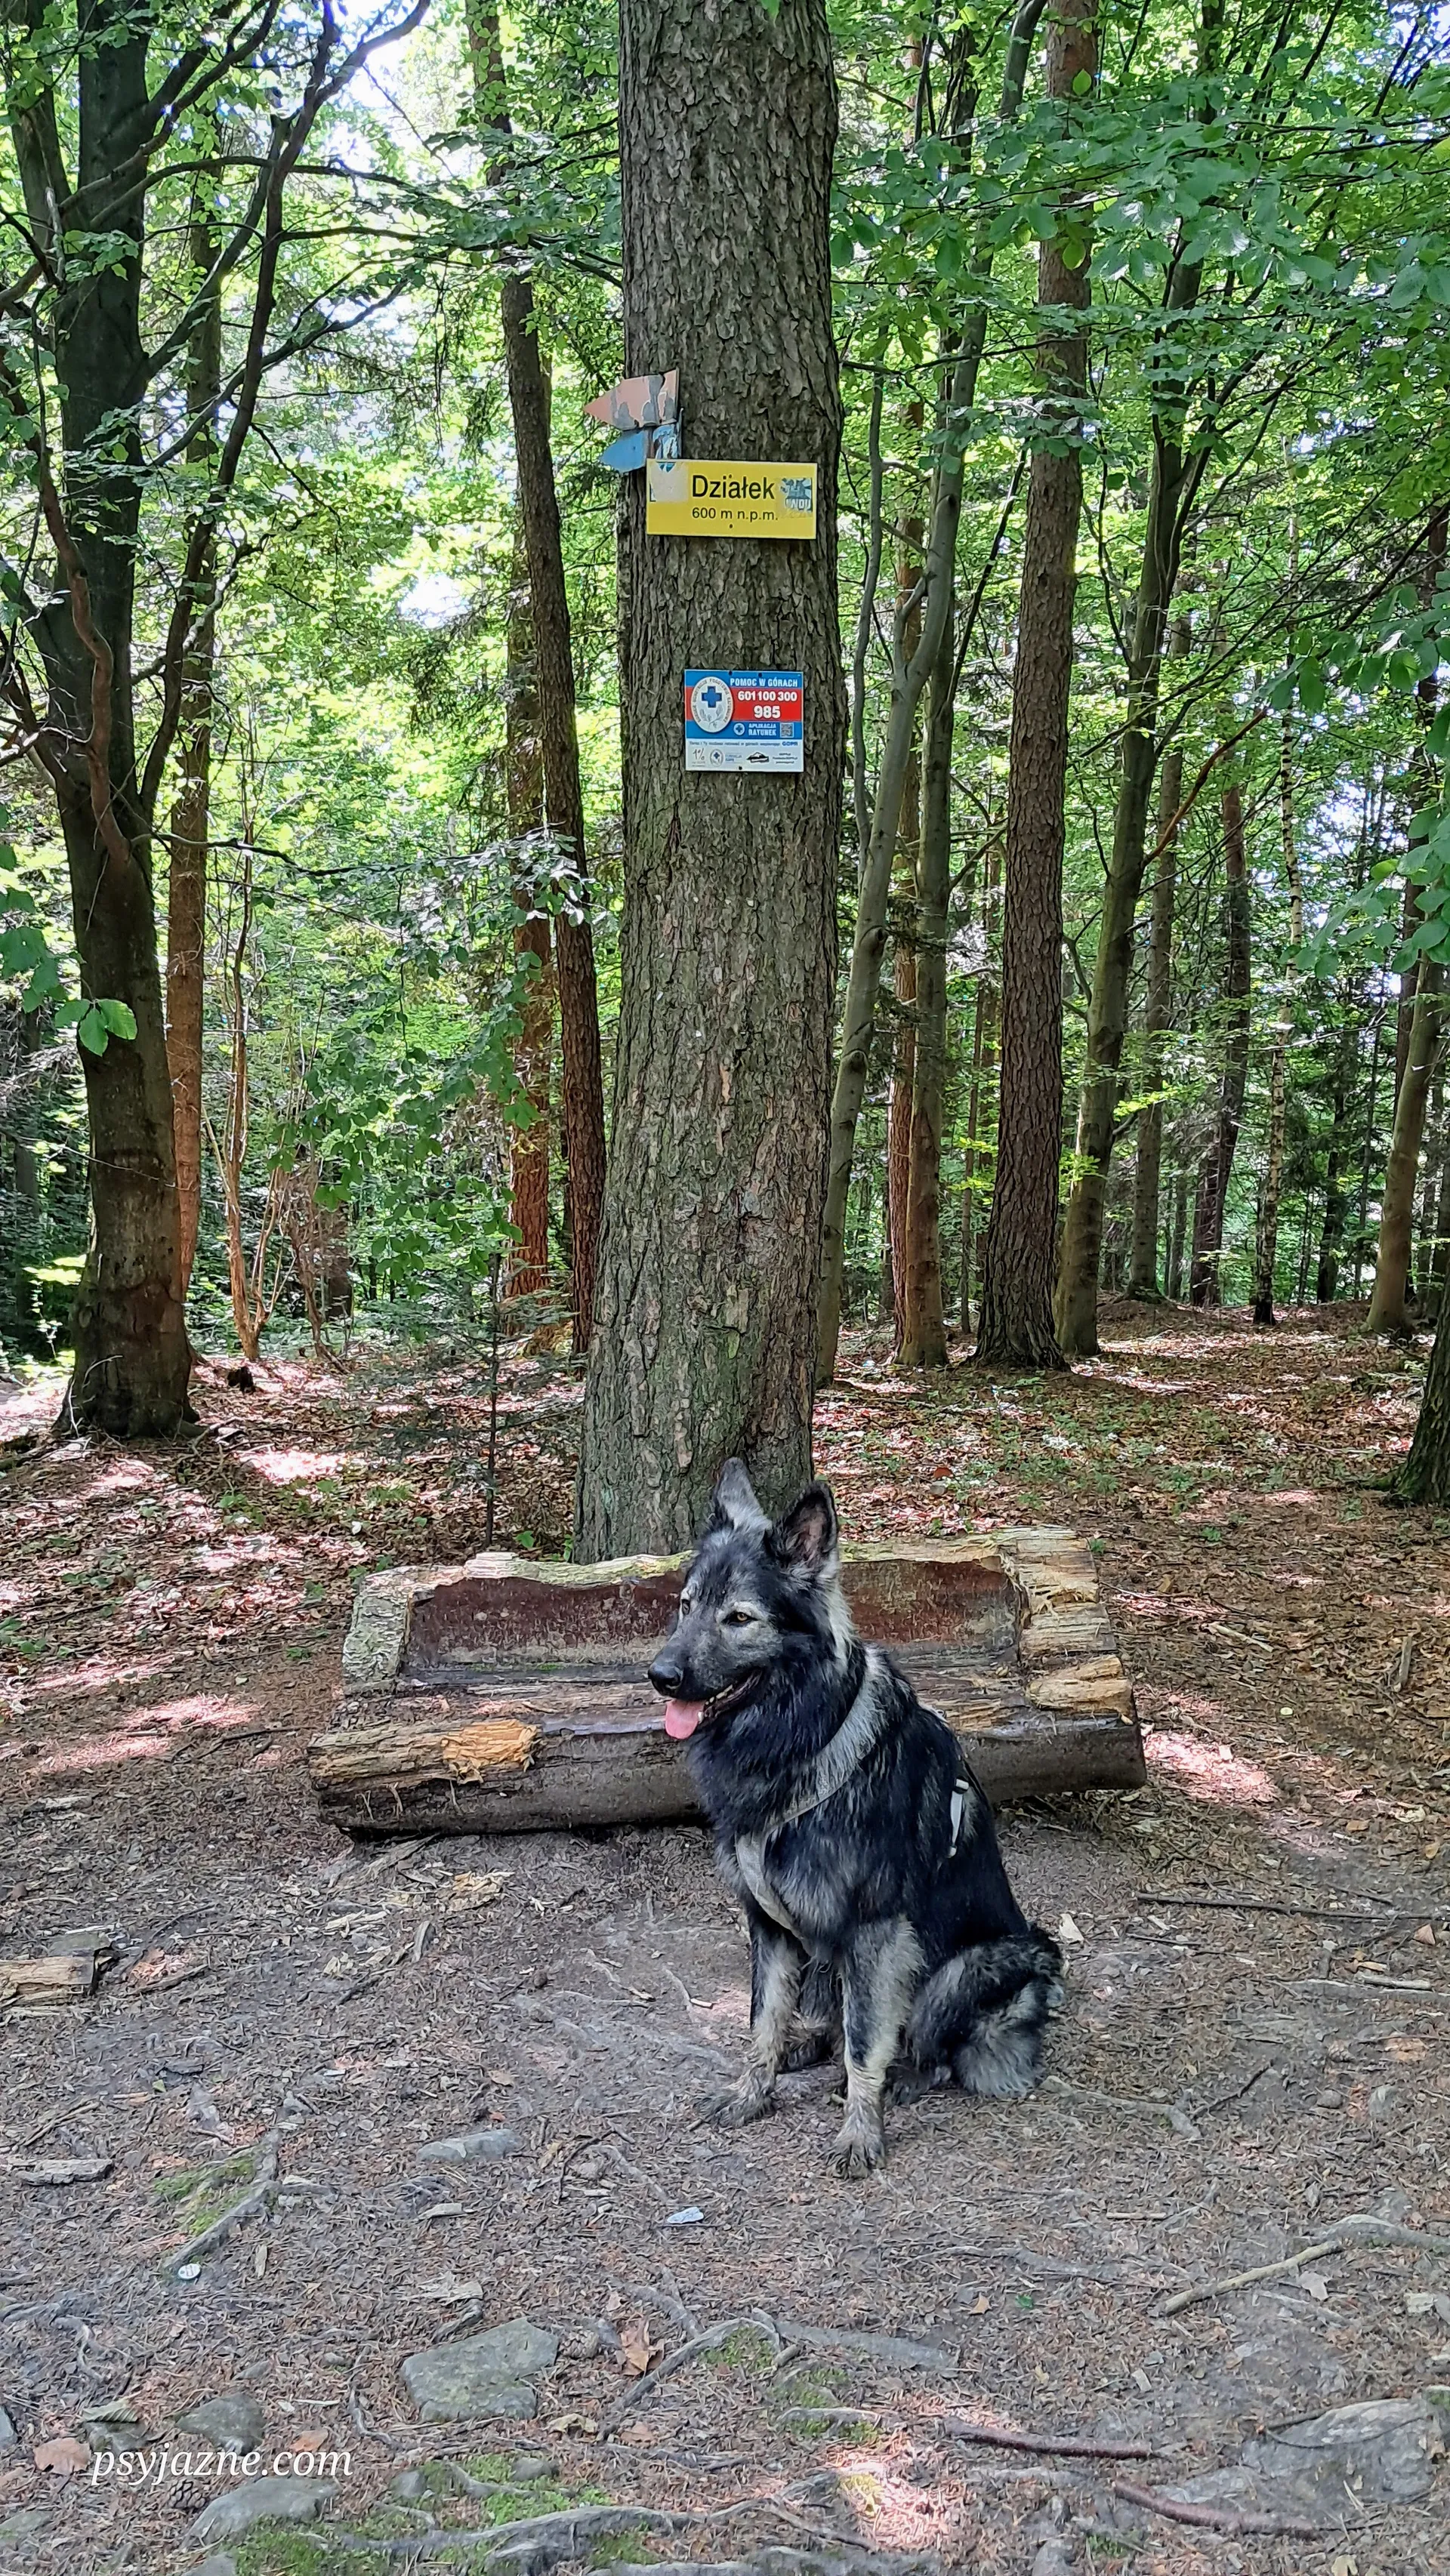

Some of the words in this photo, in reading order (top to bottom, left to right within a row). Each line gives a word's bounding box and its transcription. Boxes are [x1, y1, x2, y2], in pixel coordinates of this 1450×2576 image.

[693, 474, 775, 499] Działek
[692, 507, 716, 519] 600
[721, 510, 732, 519] m
[737, 511, 778, 522] n.p.m.
[730, 678, 756, 686] POMOC
[759, 678, 766, 686] W
[767, 677, 798, 687] GÓRACH
[738, 691, 755, 701] 601
[757, 691, 776, 701] 100
[777, 691, 798, 701] 300
[754, 705, 781, 719] 985
